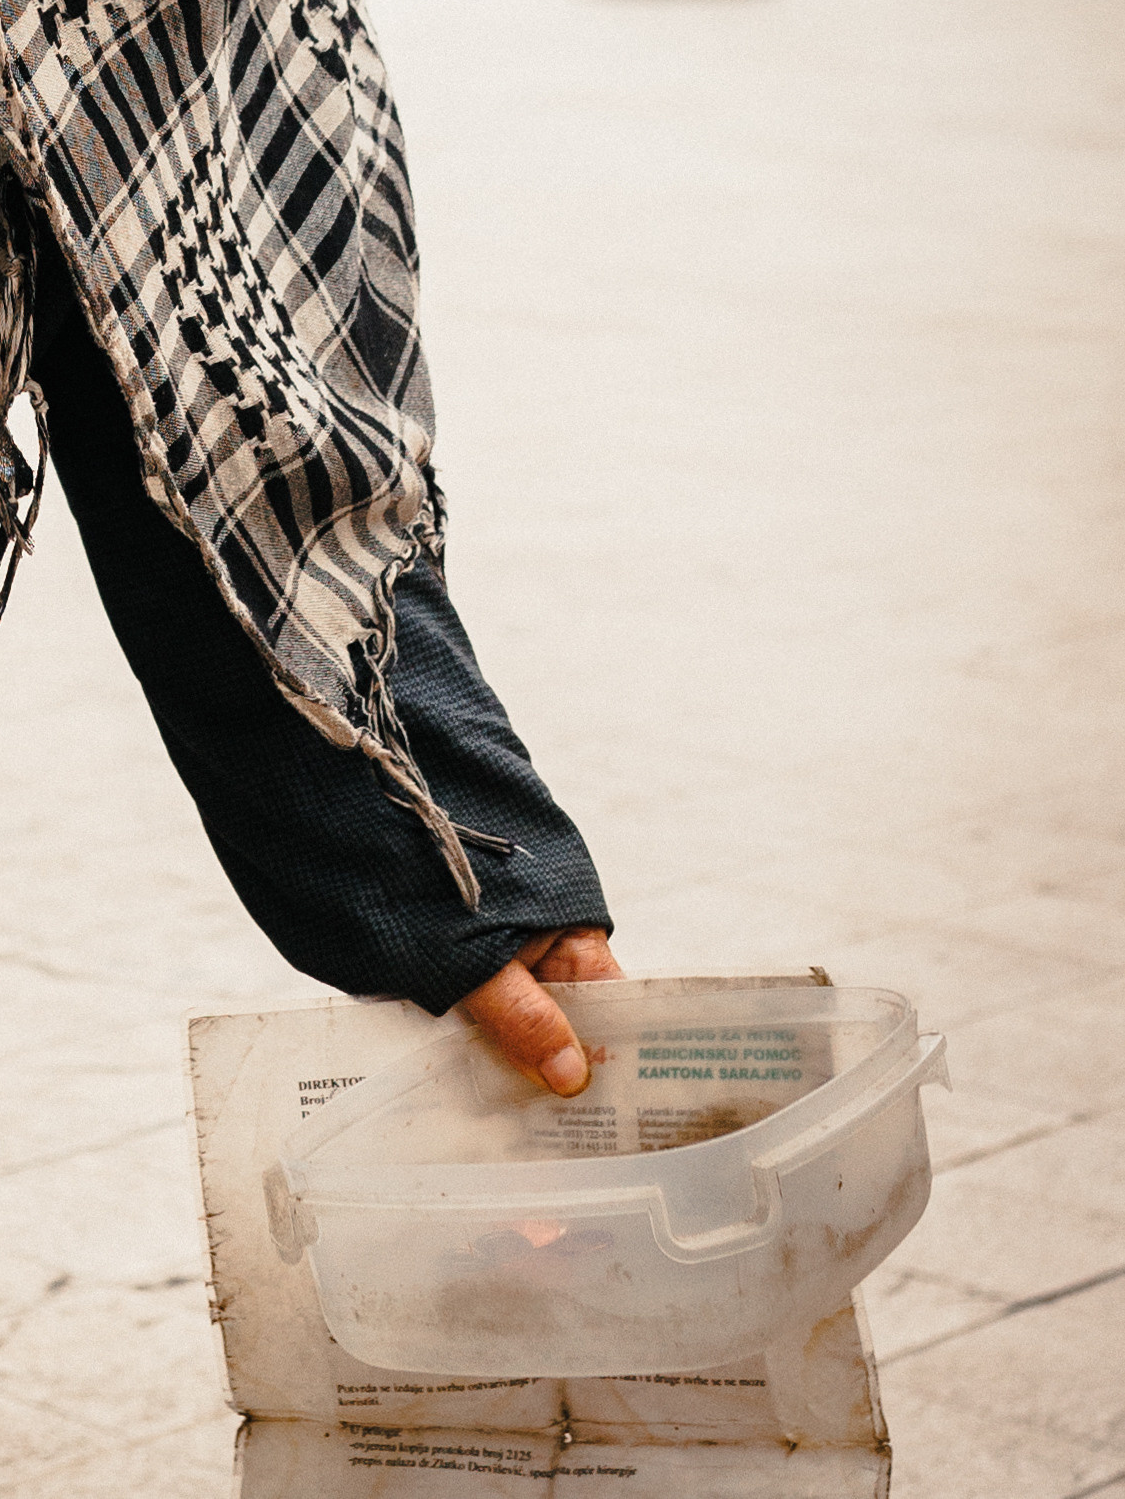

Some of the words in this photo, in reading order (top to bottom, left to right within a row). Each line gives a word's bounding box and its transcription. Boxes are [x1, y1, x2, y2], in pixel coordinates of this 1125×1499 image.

[638, 1048, 738, 1062] MEDICINSKU
[638, 1067, 715, 1081] KANTONA
[719, 1067, 804, 1082] SARAJEVO
[298, 1076, 366, 1091] DIREKTO
[654, 1374, 681, 1386] druge
[337, 1383, 378, 1393] Potvrda
[394, 1383, 424, 1395] izdaje
[398, 1442, 430, 1455] kopija
[431, 1445, 480, 1458] protokola
[482, 1447, 504, 1462] broj
[506, 1449, 532, 1462] 2125
